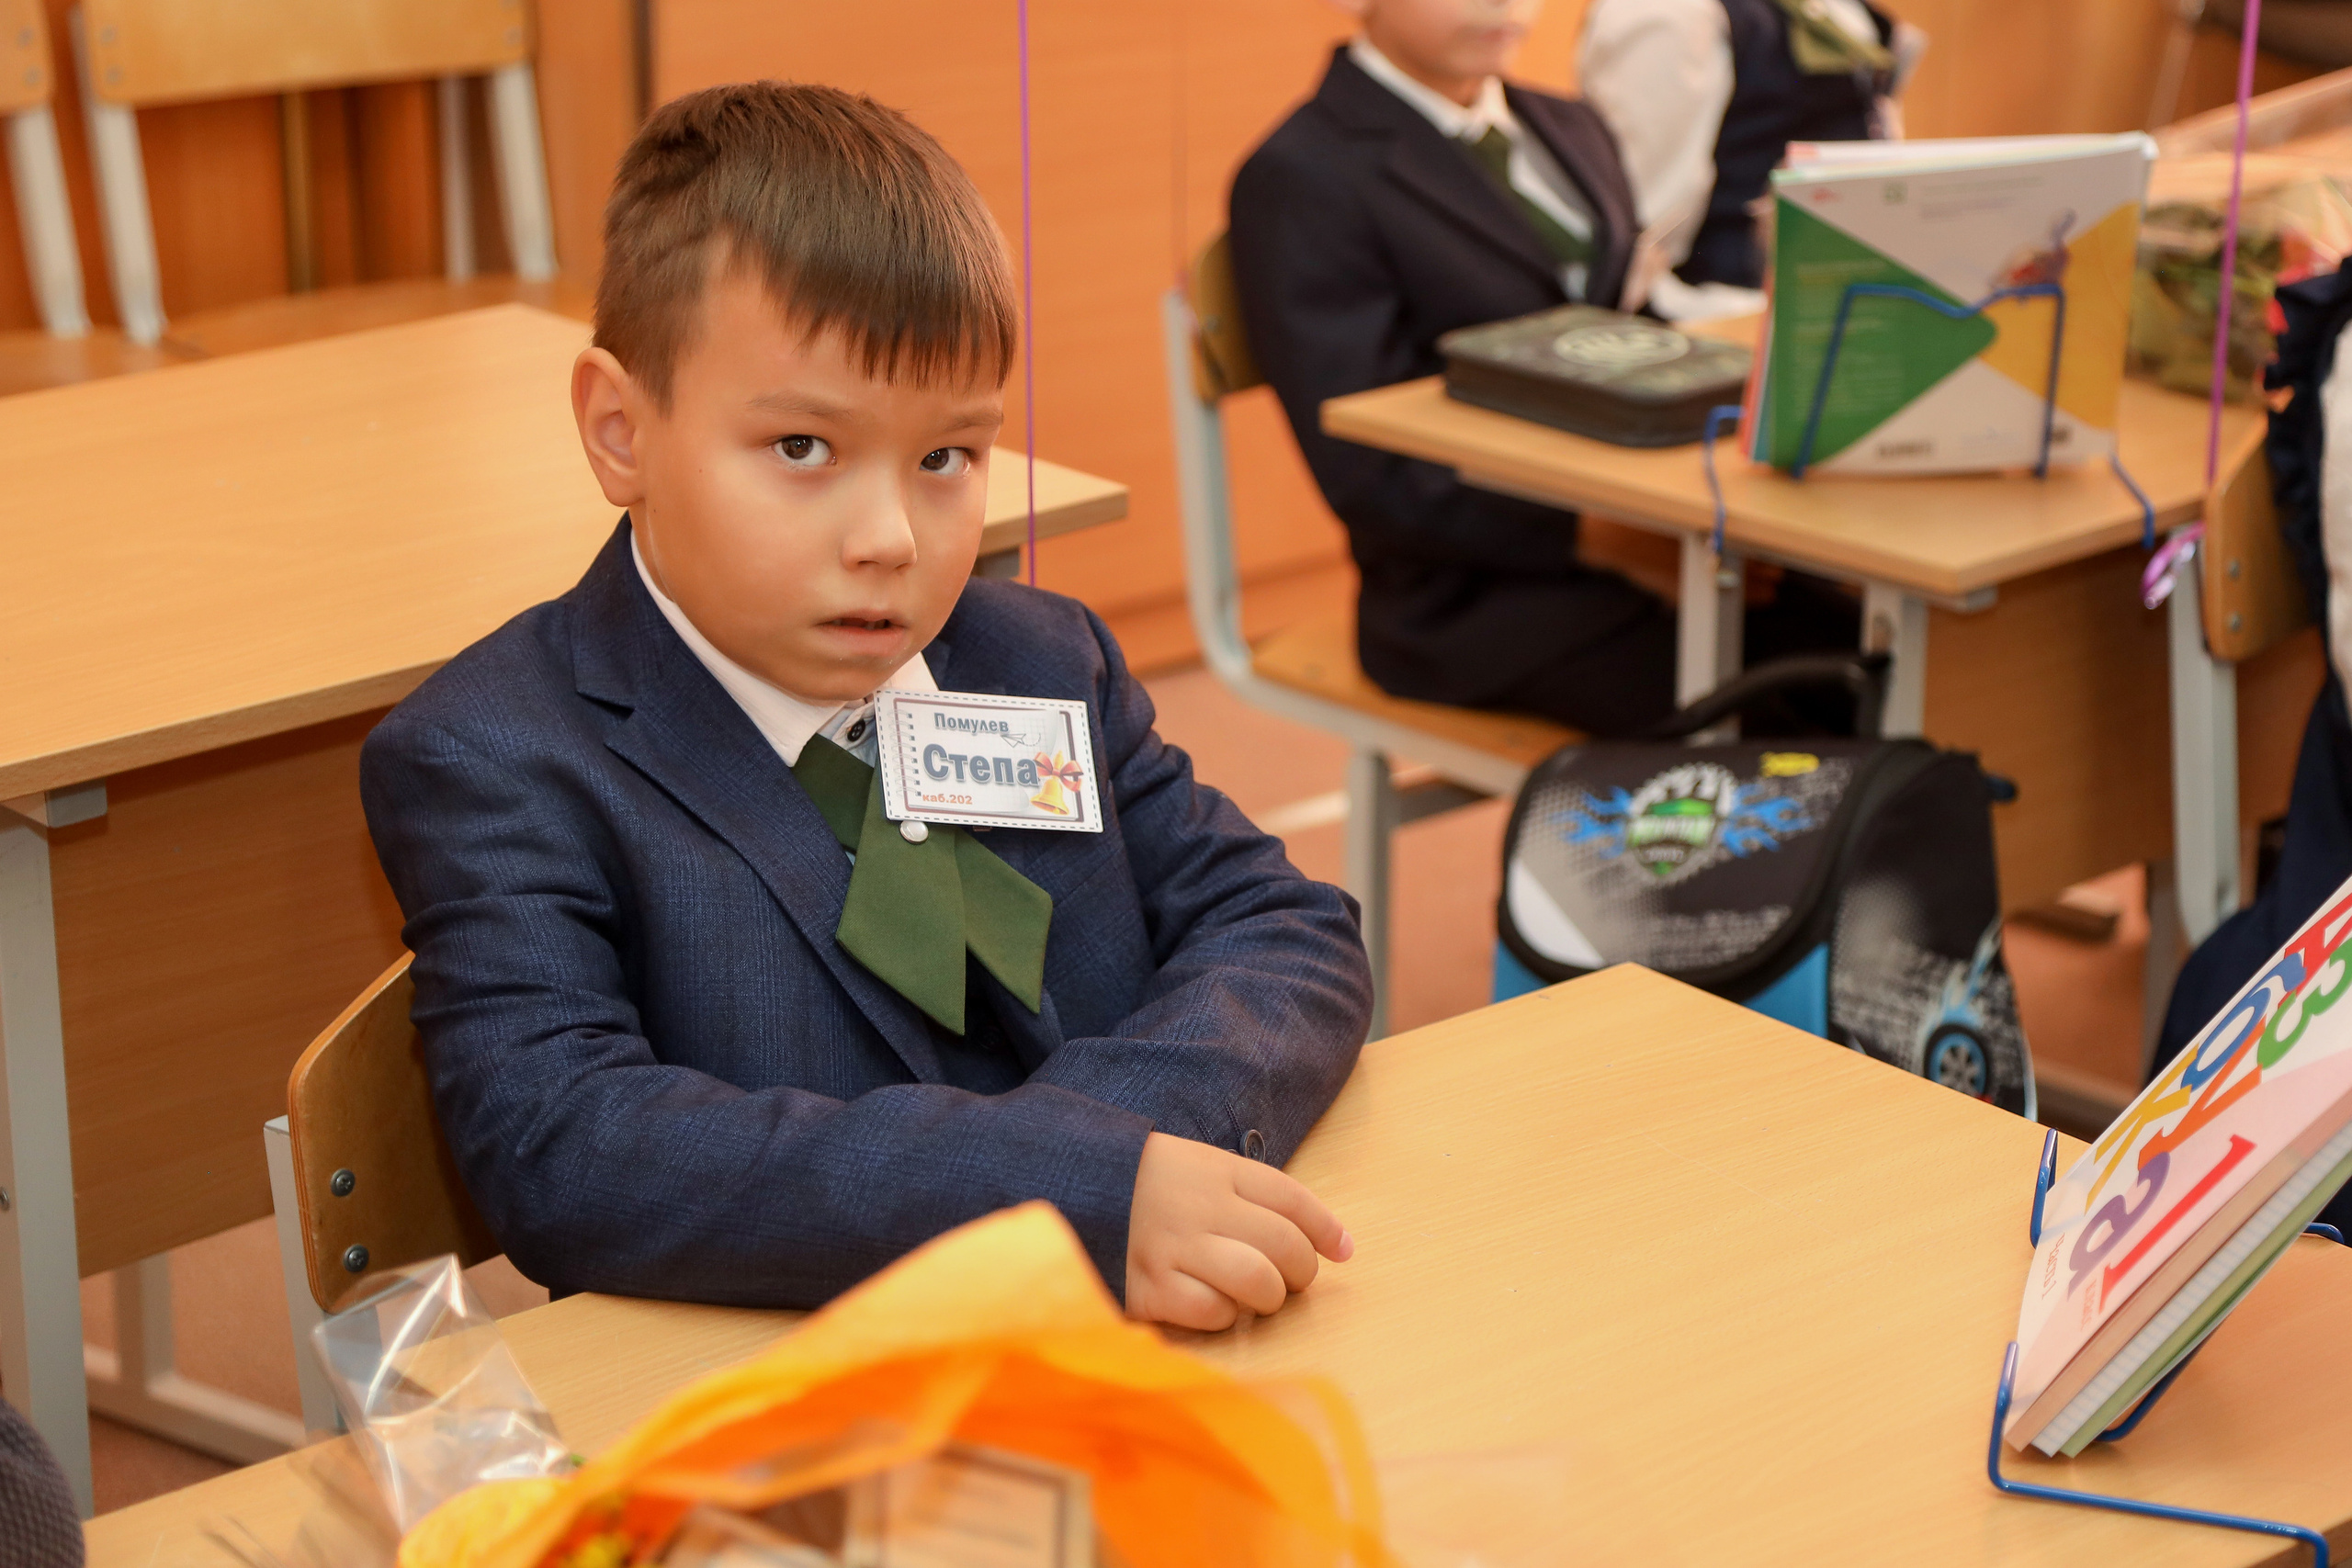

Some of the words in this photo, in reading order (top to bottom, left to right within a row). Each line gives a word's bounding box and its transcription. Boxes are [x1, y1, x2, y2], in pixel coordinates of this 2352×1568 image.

[933, 712, 1010, 735] Помулев
[922, 743, 1040, 786] Степа
[922, 793, 974, 806] каб.202
[2098, 1134, 2257, 1314] 1
